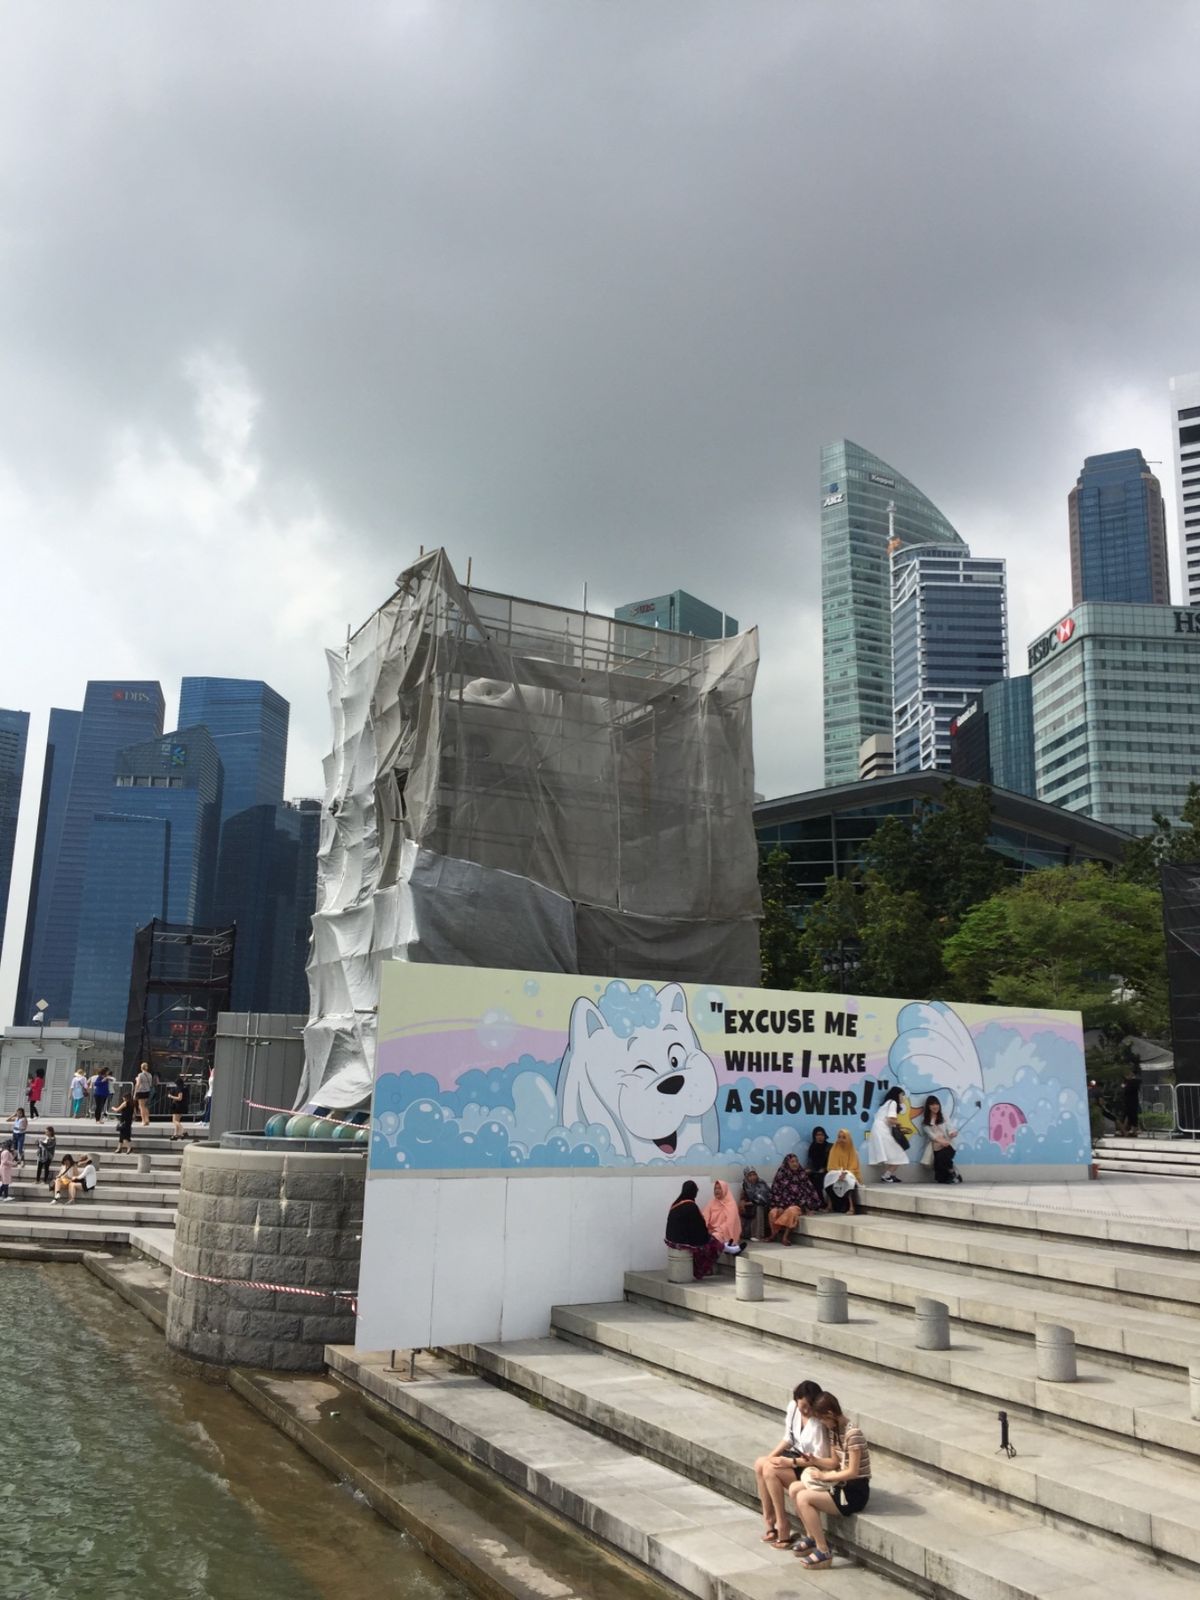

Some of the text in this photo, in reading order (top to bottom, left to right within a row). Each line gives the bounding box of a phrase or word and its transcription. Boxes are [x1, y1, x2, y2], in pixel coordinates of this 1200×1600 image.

[1028, 629, 1058, 669] HSBC
[124, 690, 150, 703] DBS
[710, 1001, 858, 1037] "EXCUSE ME
[724, 1050, 866, 1078] WHILE I TAKE
[725, 1079, 889, 1123] A SHOWER!"
